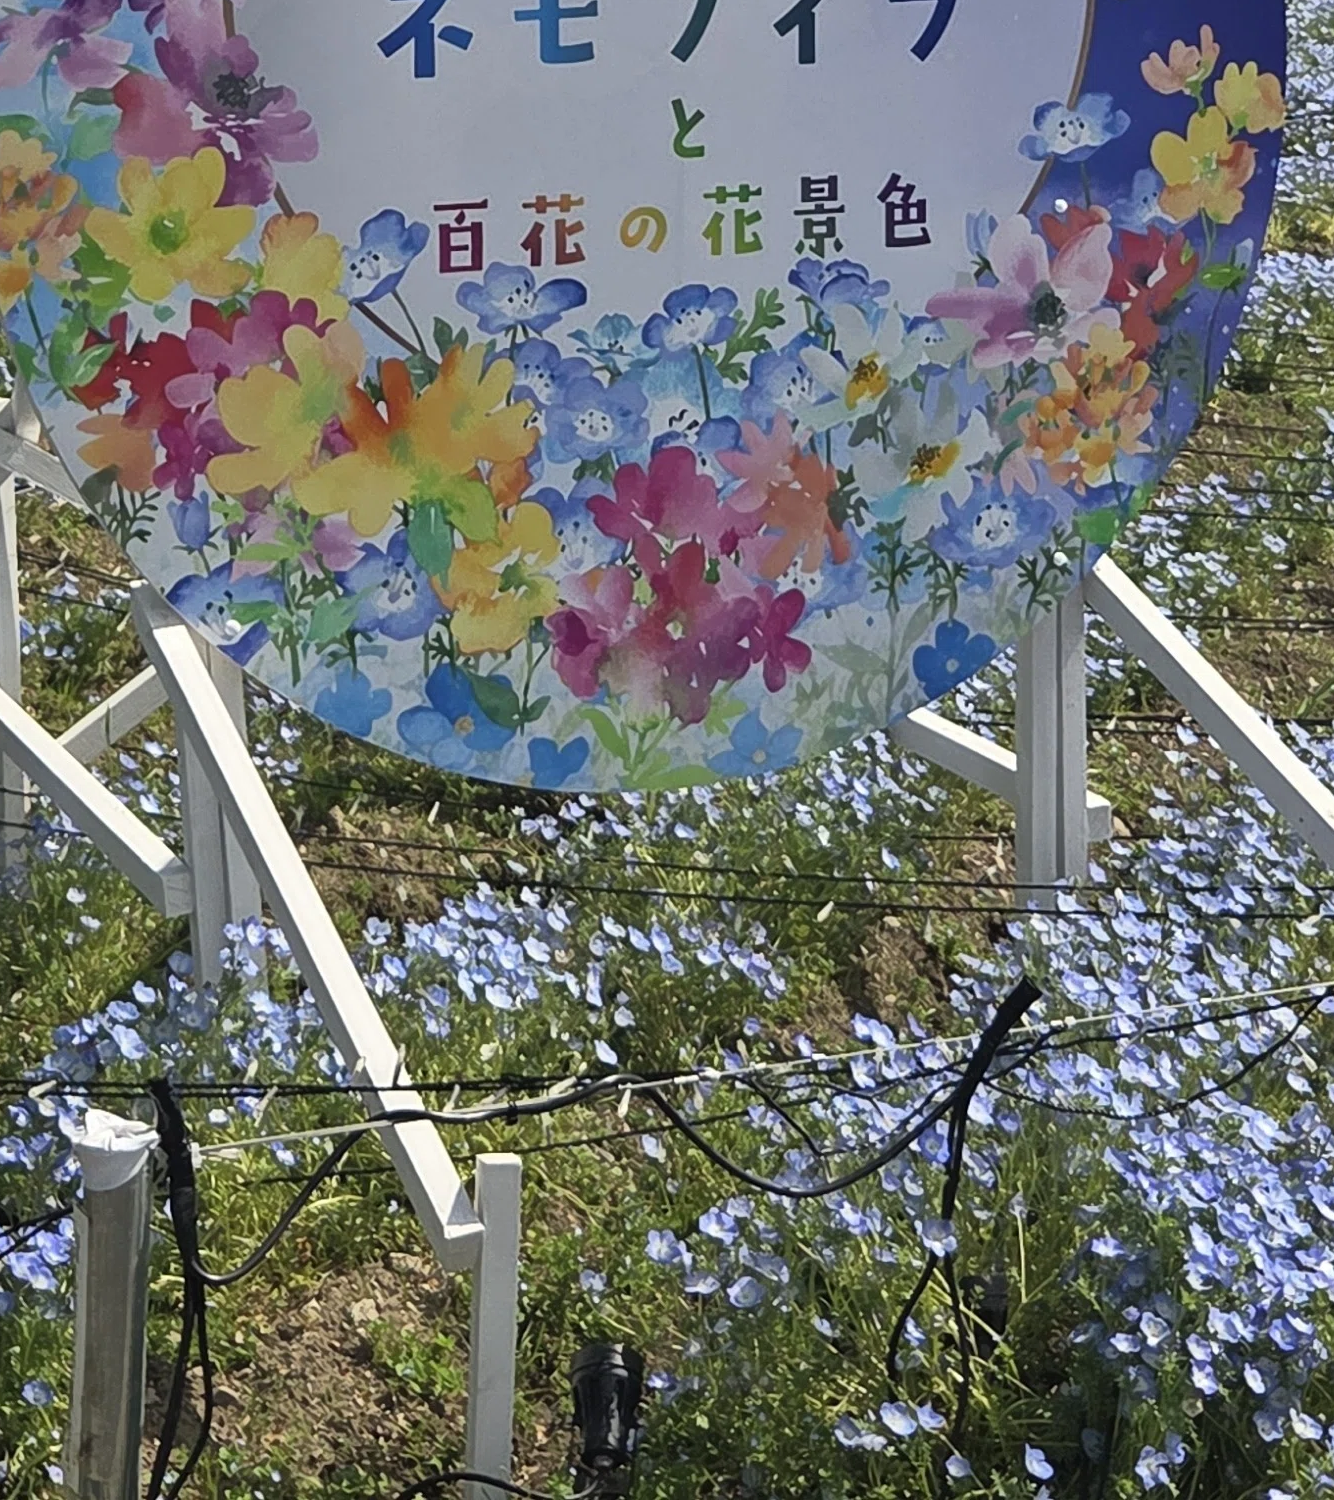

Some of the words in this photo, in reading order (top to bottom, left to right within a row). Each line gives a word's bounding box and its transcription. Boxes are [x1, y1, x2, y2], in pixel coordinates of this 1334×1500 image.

[670, 98, 706, 158] と
[433, 172, 932, 274] 百花の花景色
